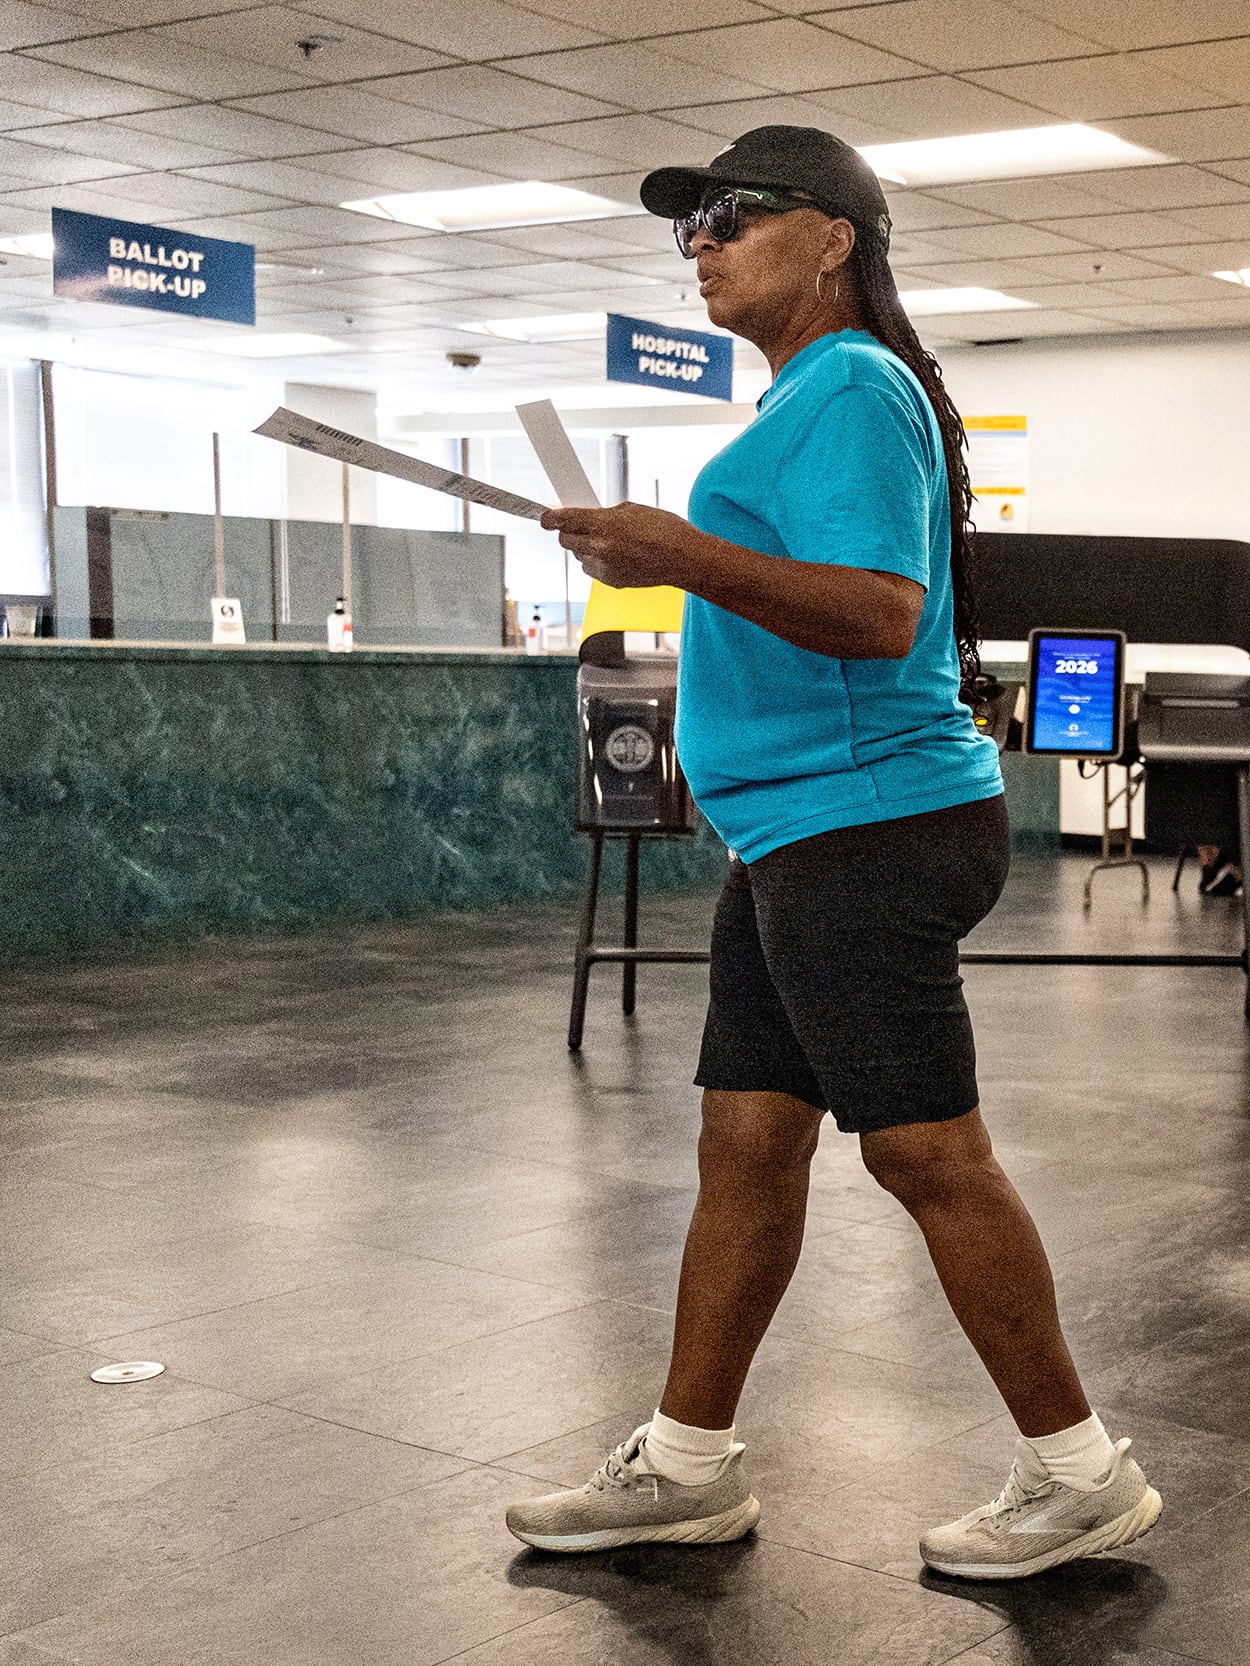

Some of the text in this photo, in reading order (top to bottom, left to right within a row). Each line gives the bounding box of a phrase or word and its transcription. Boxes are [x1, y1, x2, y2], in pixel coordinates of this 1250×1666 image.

[109, 237, 204, 272] BALLOT
[107, 264, 206, 299] PICK-UP
[631, 333, 710, 364] HOSPITAL
[638, 355, 704, 382] PICK-UP
[1055, 660, 1098, 674] 2026
